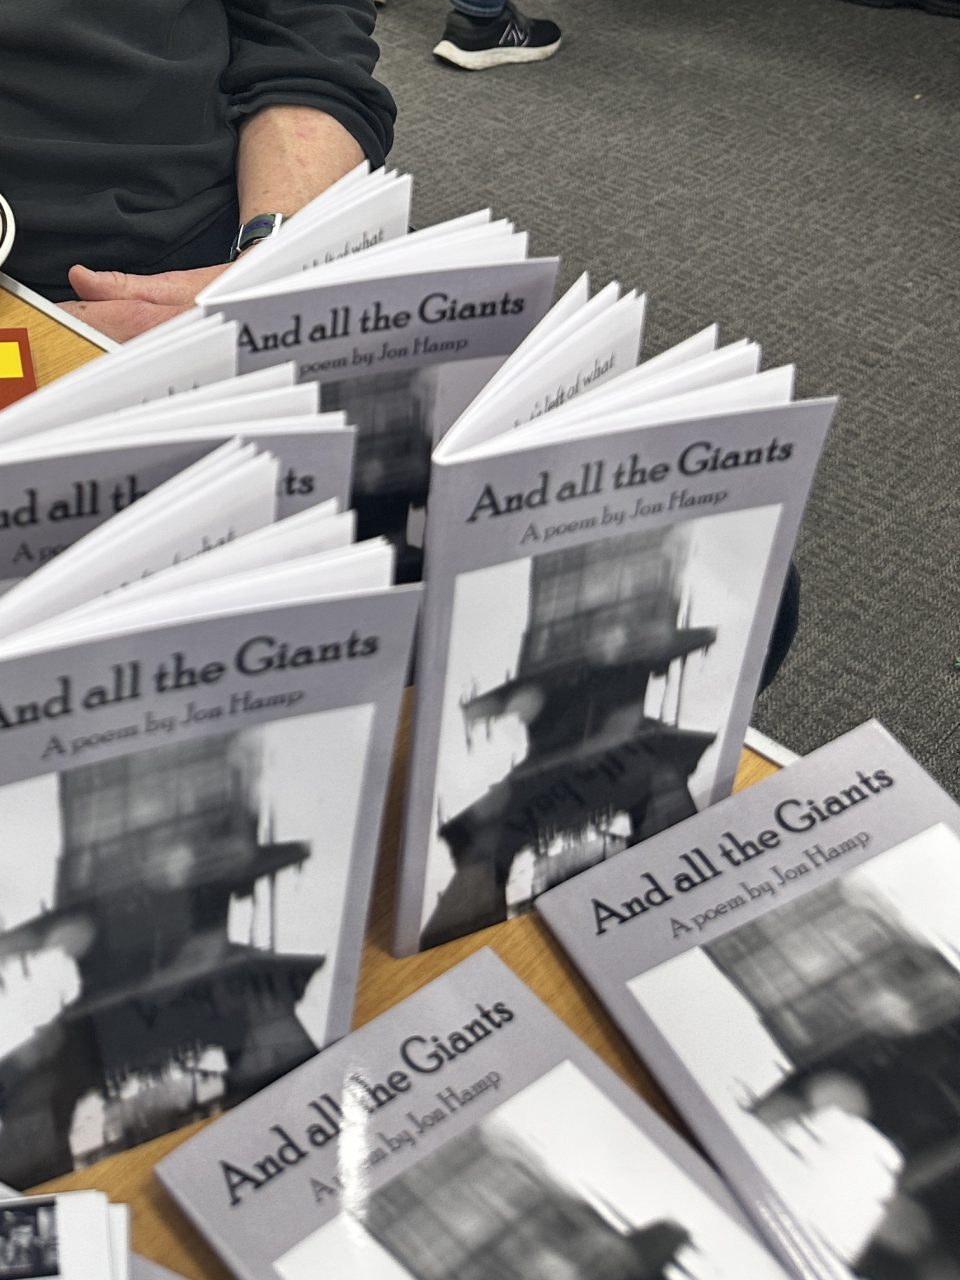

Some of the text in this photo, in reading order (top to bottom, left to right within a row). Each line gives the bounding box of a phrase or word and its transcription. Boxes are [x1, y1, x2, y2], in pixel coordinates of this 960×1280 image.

[352, 227, 384, 254] what
[238, 291, 525, 354] And all the Giants
[545, 351, 615, 414] left of what
[47, 479, 100, 521] all
[110, 474, 149, 515] th
[465, 437, 795, 523] And all the Giants
[519, 487, 729, 545] A poem by Jon Hamp
[82, 660, 141, 711] all
[153, 650, 227, 694] the
[235, 629, 380, 677] Giants
[41, 689, 307, 759] A poem by Jon Hamp
[591, 768, 895, 936] And all the Giants
[668, 828, 872, 939] A poem by Jon Hamp
[218, 1124, 310, 1208] And
[307, 1093, 344, 1148] all
[400, 1000, 516, 1074] Giants
